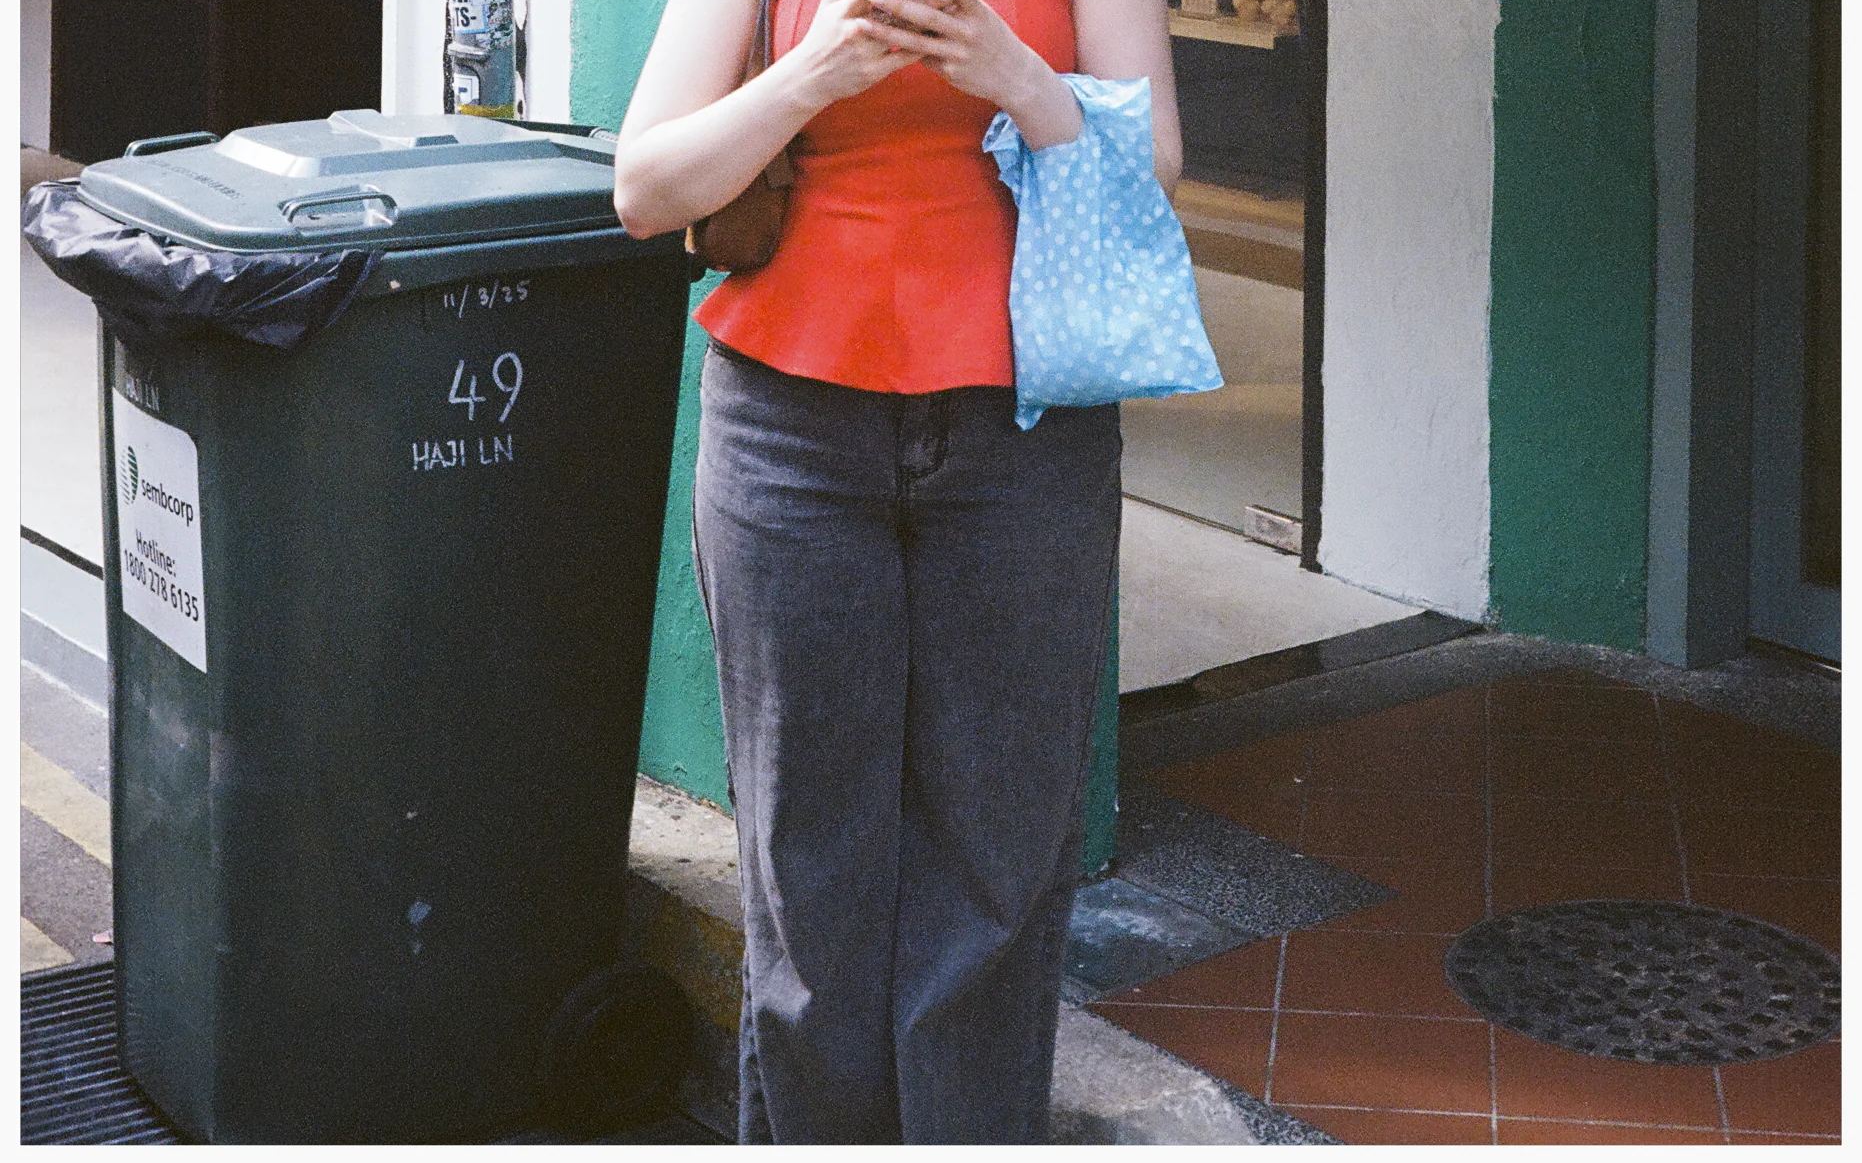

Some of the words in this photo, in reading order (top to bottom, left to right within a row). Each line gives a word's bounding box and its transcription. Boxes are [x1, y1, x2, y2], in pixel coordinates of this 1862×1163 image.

[448, 351, 524, 424] 49
[412, 438, 466, 472] HAJI
[479, 434, 514, 466] LN
[141, 478, 195, 527] sembcorp
[135, 528, 177, 578] Hotline:
[124, 549, 147, 586] 1800
[148, 567, 168, 602] 278
[170, 583, 199, 622] 6135
